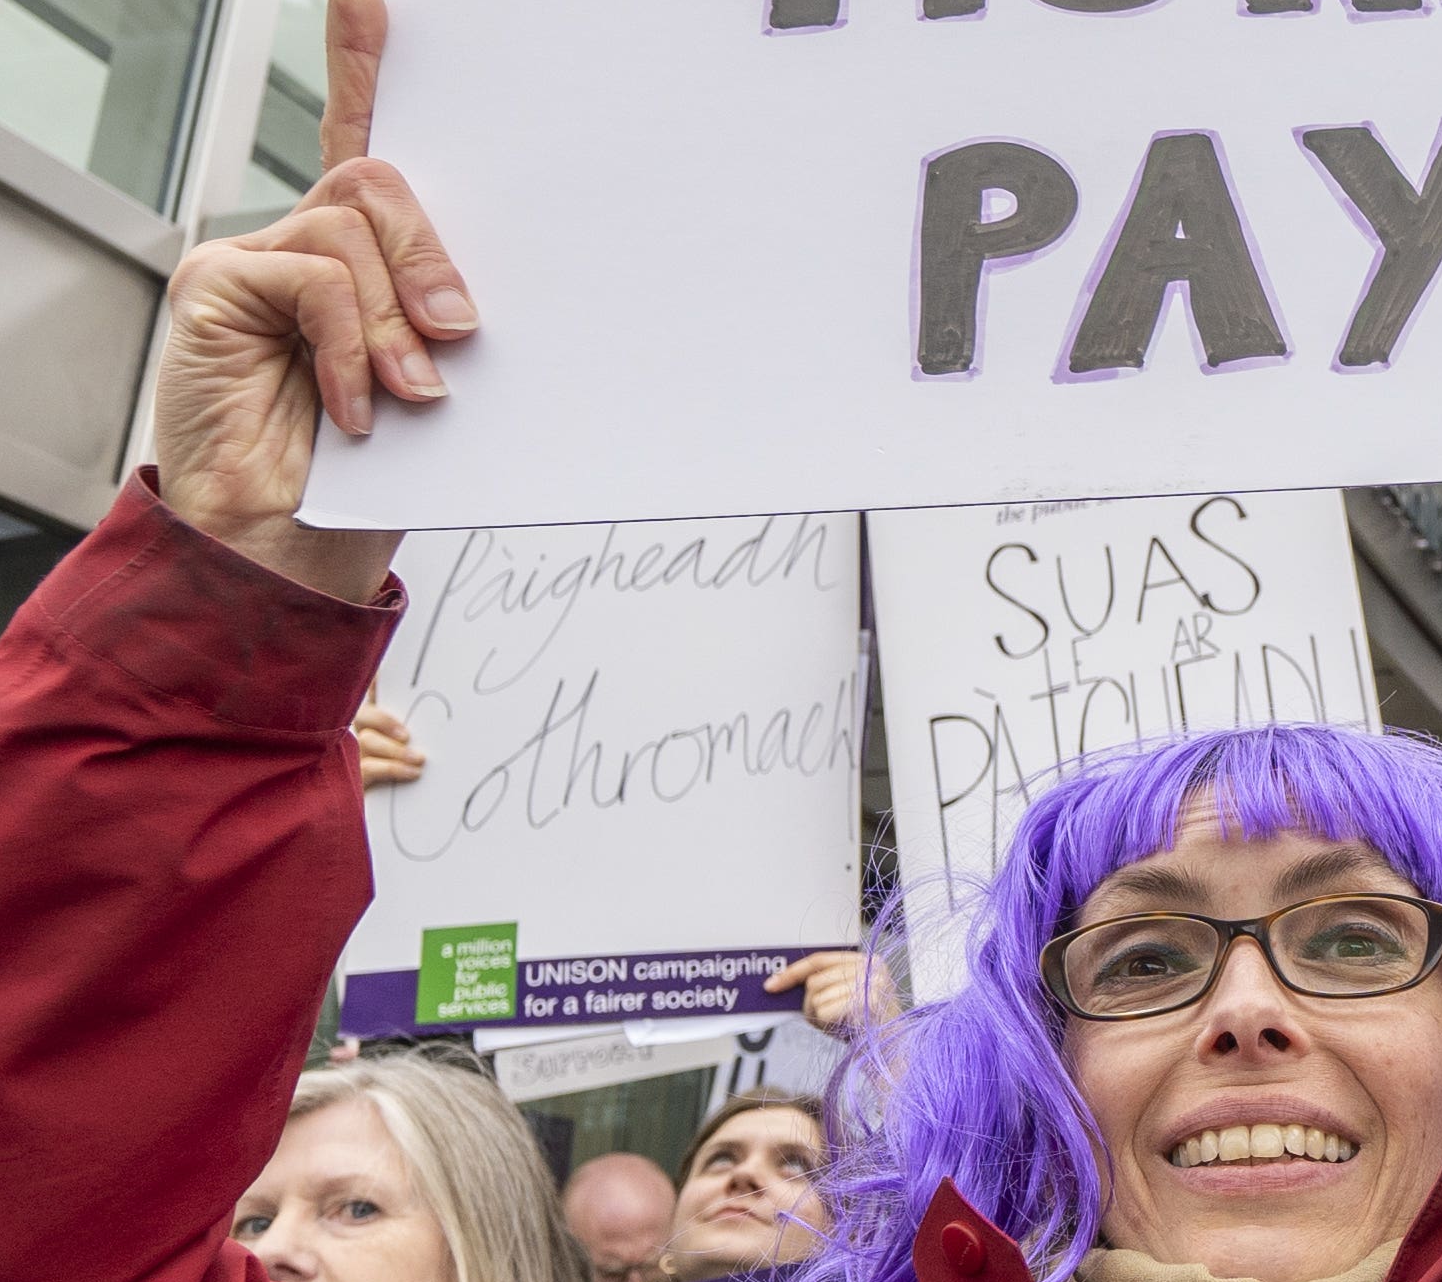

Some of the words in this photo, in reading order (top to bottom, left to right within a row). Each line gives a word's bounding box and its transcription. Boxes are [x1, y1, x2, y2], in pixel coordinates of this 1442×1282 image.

[986, 496, 1261, 660] SUAS
[441, 942, 453, 959] a
[456, 969, 479, 985] for
[524, 957, 628, 988] UNISON
[633, 952, 788, 984] campaigning
[438, 998, 511, 1017] services
[524, 993, 557, 1018] for
[563, 995, 580, 1015] a
[584, 988, 648, 1014] fairer
[651, 985, 739, 1013] society
